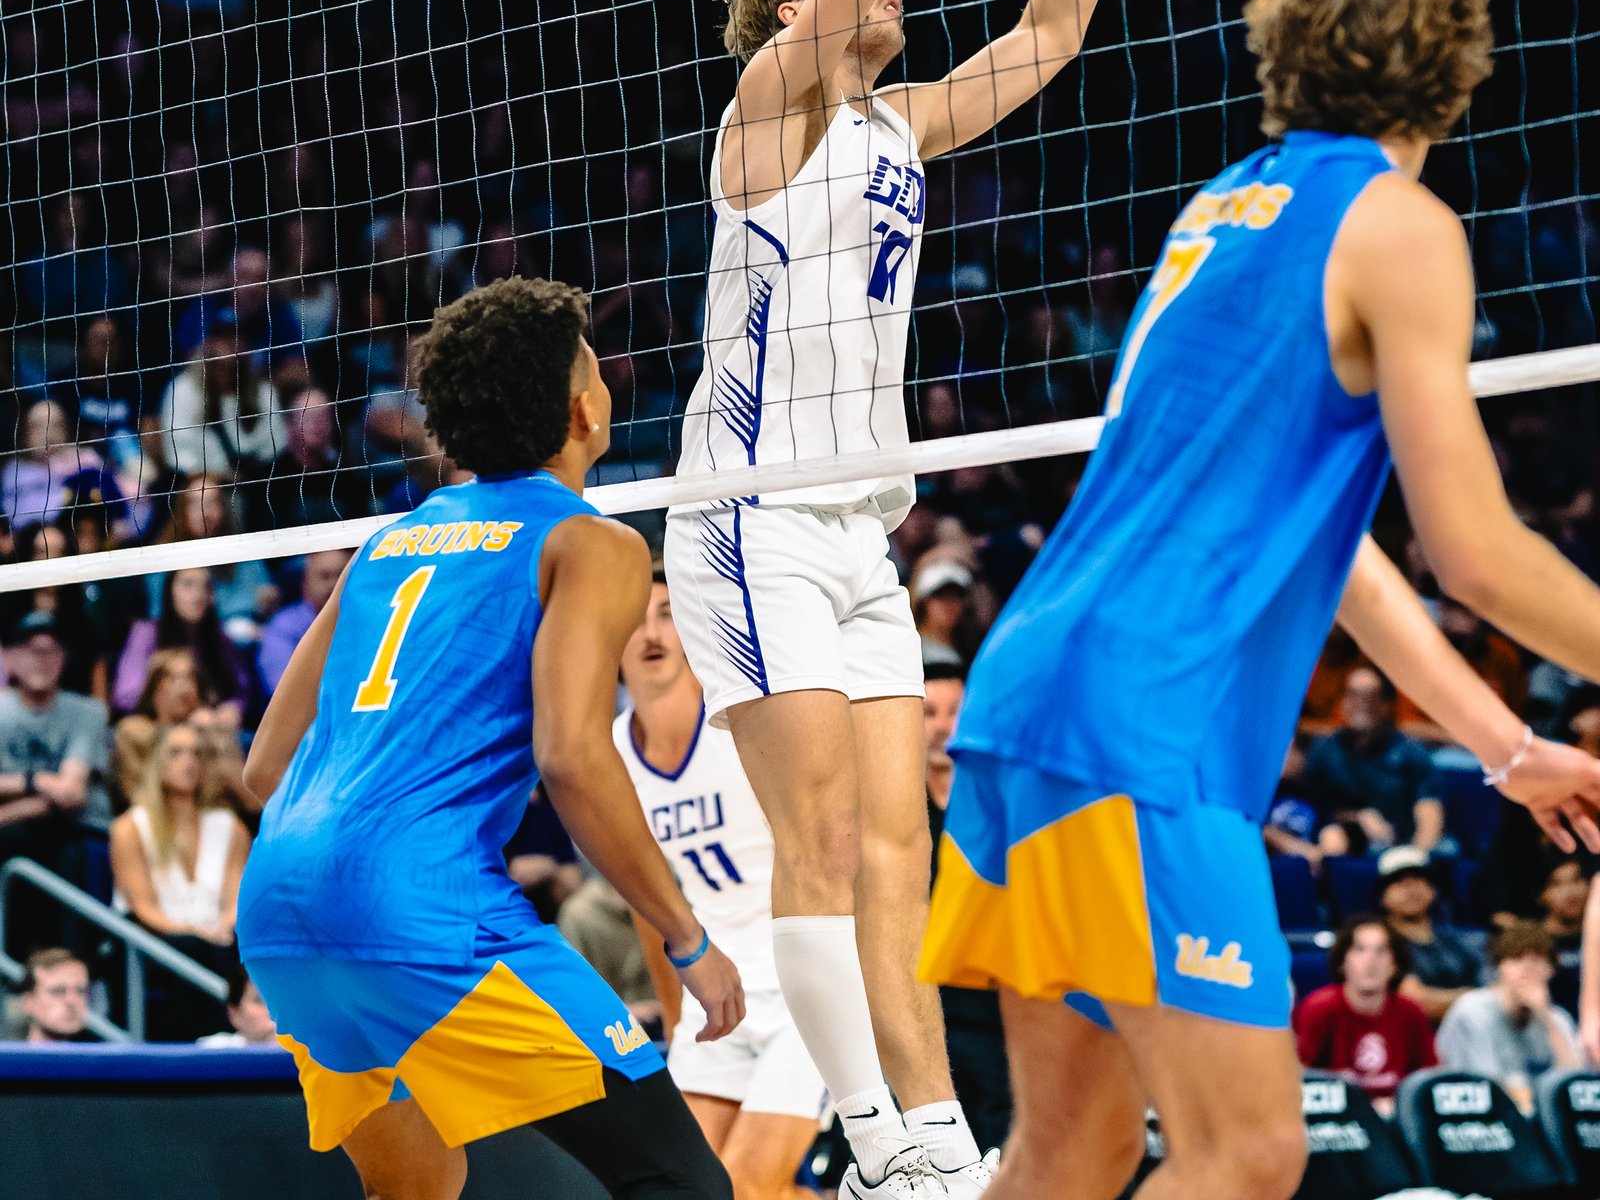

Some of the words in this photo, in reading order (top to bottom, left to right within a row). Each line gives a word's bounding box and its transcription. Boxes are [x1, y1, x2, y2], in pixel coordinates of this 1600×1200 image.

[1105, 238, 1217, 421] 7
[368, 520, 525, 562] BRUINS
[351, 565, 437, 712] 1
[651, 792, 725, 842] GCU
[682, 841, 744, 892] 11
